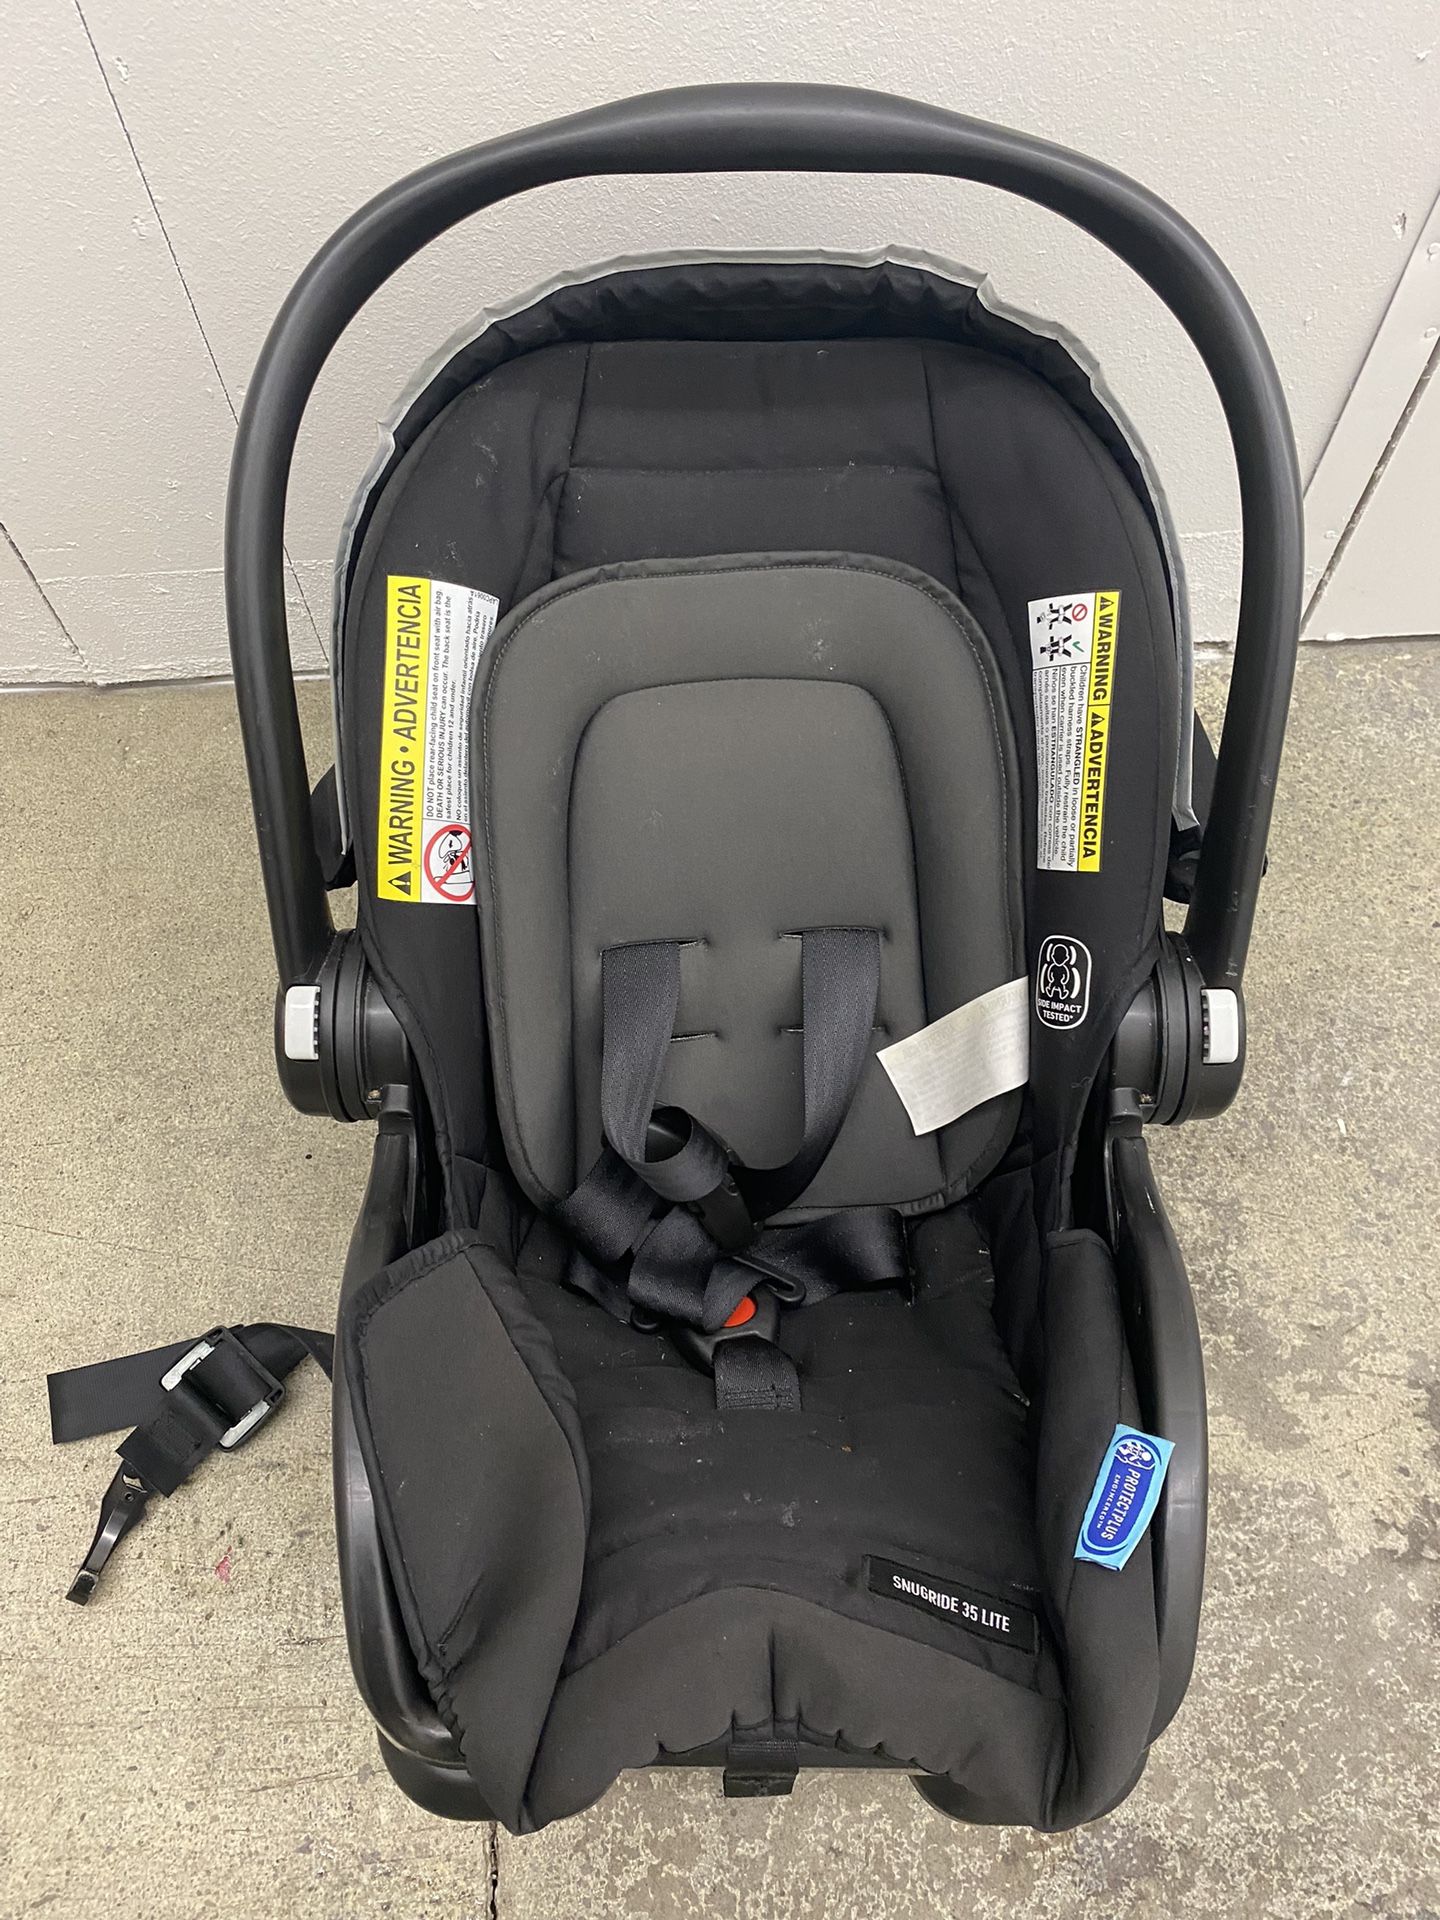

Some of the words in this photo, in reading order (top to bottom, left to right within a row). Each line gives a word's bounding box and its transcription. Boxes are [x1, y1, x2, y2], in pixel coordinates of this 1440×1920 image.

[434, 589, 443, 604] bag.
[393, 584, 421, 742] ADVERTENCIA
[1093, 613, 1113, 700] WARNING
[433, 673, 438, 682] on
[1069, 666, 1077, 700] buckled
[1078, 665, 1088, 701] Children
[448, 720, 454, 728] 12
[1067, 703, 1075, 736] harness
[429, 723, 438, 763] rear-facing
[457, 732, 462, 741] de
[1073, 727, 1083, 784] STRANGLED
[427, 765, 435, 785] place
[437, 779, 443, 790] OR
[457, 769, 461, 778] un
[1083, 729, 1103, 858] ADVERTENCIA
[388, 761, 415, 864] WARNING
[426, 805, 434, 817] DO
[456, 809, 461, 820] NO
[1070, 823, 1076, 831] or
[1067, 834, 1076, 867] partially
[1038, 998, 1050, 1008] SIDE
[1051, 1002, 1082, 1013] IMPACT
[1101, 1468, 1140, 1541] PROTECTPLUS
[892, 1575, 959, 1613] SNUGRIDE
[962, 1601, 978, 1622] 35
[981, 1608, 1010, 1633] LITE
